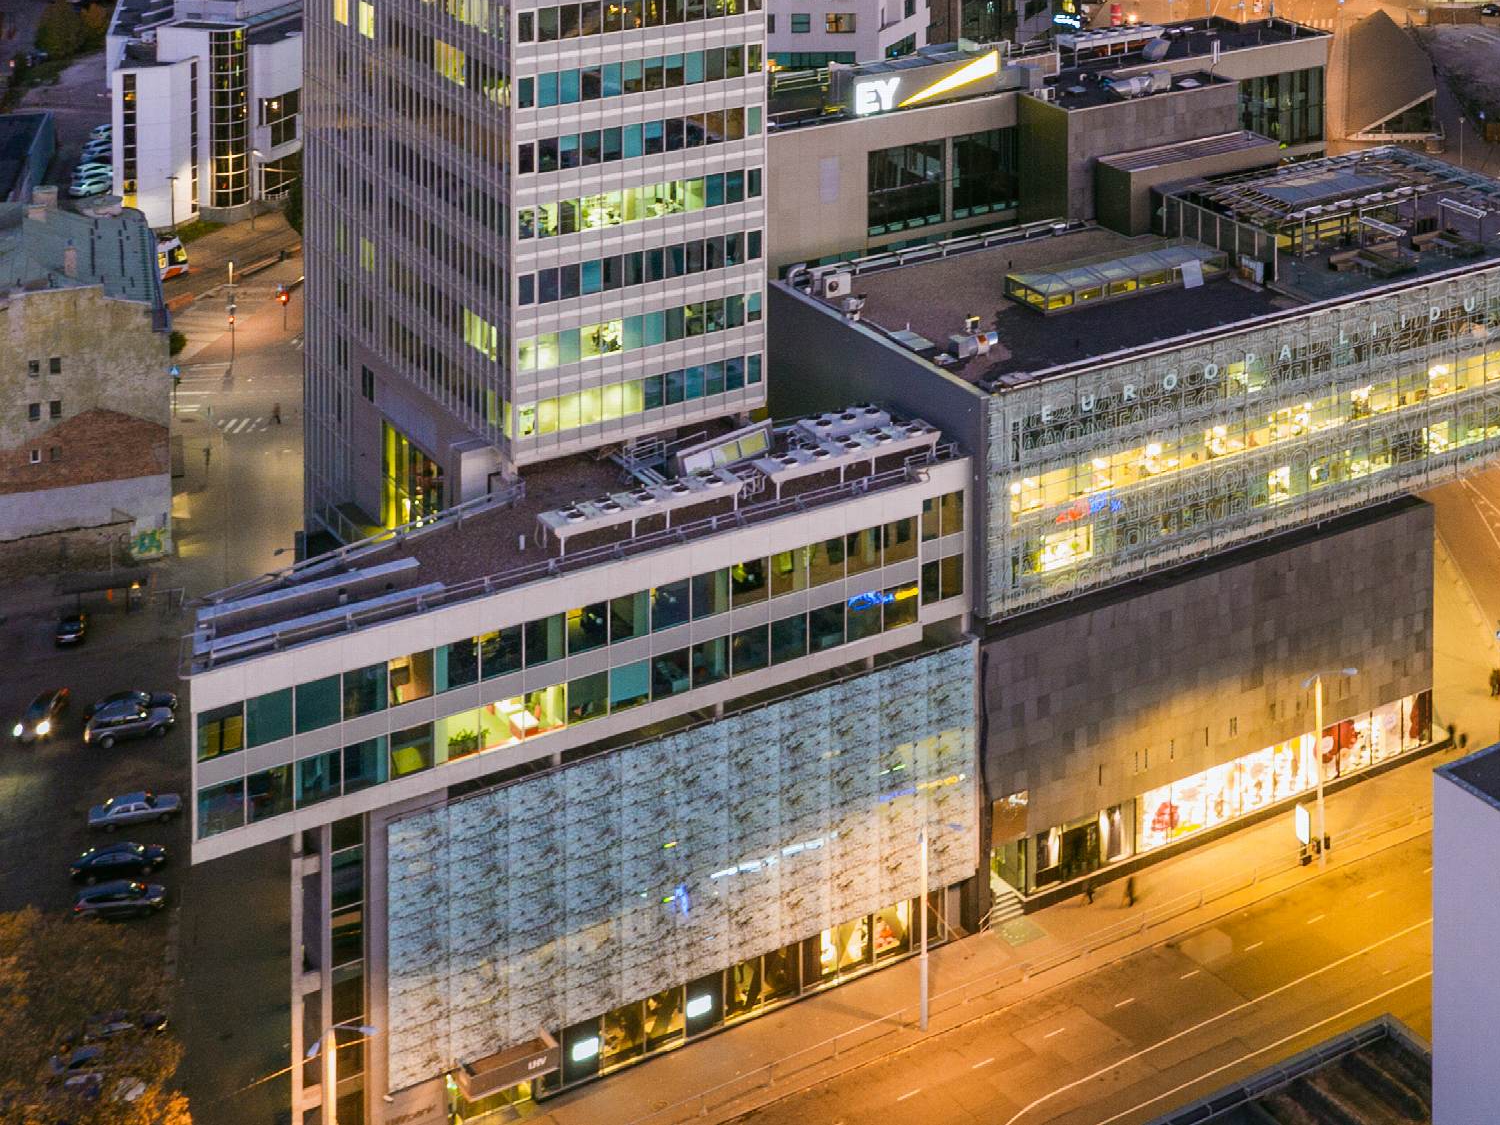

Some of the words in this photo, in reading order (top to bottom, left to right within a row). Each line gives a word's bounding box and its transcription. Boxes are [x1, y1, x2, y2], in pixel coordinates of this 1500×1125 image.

[855, 77, 901, 115] EY
[1041, 344, 1292, 423] EUROOPA
[1339, 297, 1477, 346] LIIDU
